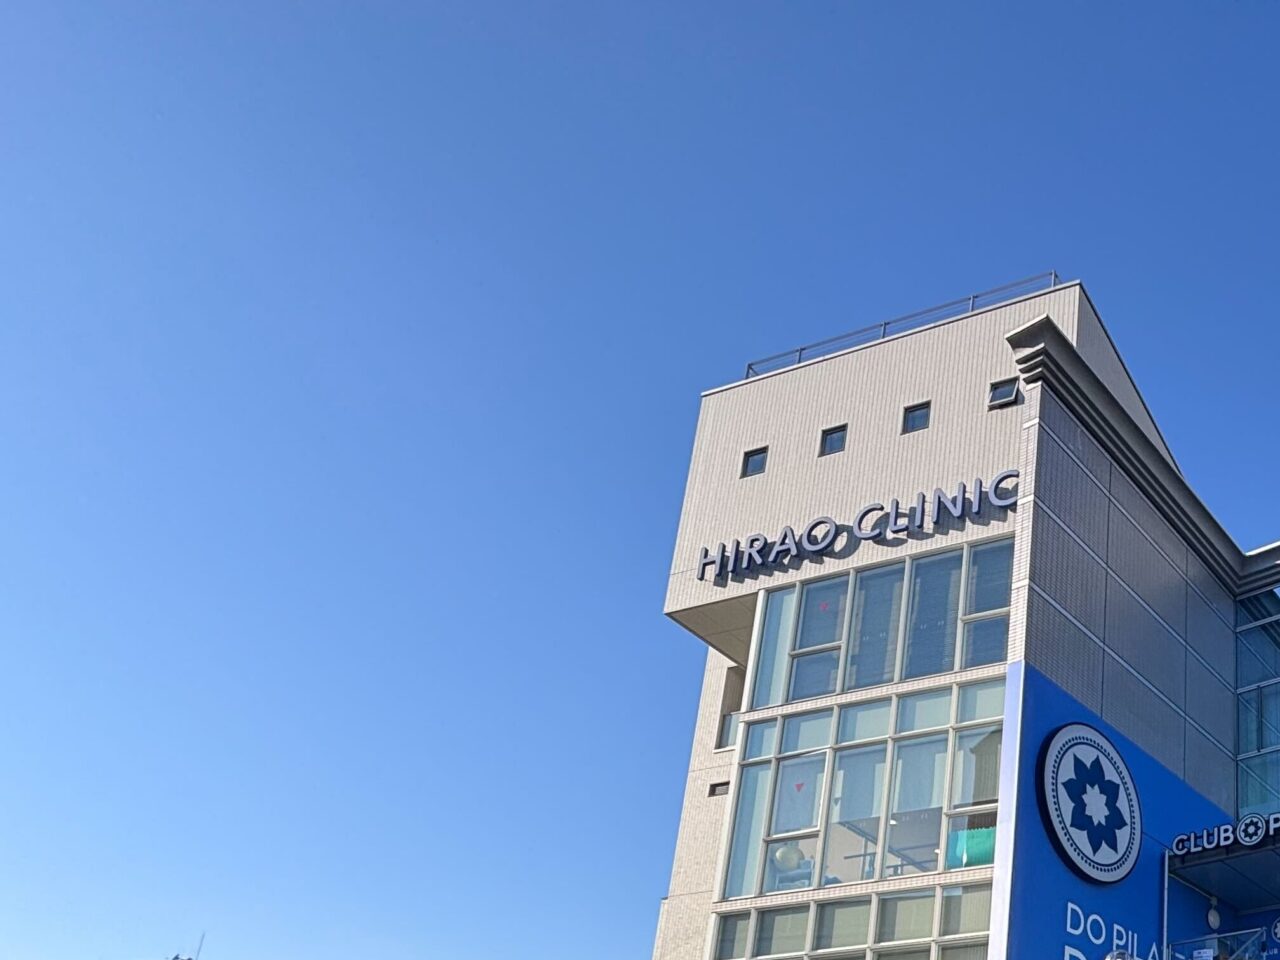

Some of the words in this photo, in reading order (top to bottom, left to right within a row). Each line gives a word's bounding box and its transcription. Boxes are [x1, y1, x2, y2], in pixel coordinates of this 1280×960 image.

[696, 516, 838, 581] HIRAO
[852, 469, 1020, 541] CLINIC
[1172, 824, 1234, 855] CLUB
[1066, 901, 1106, 945] DO
